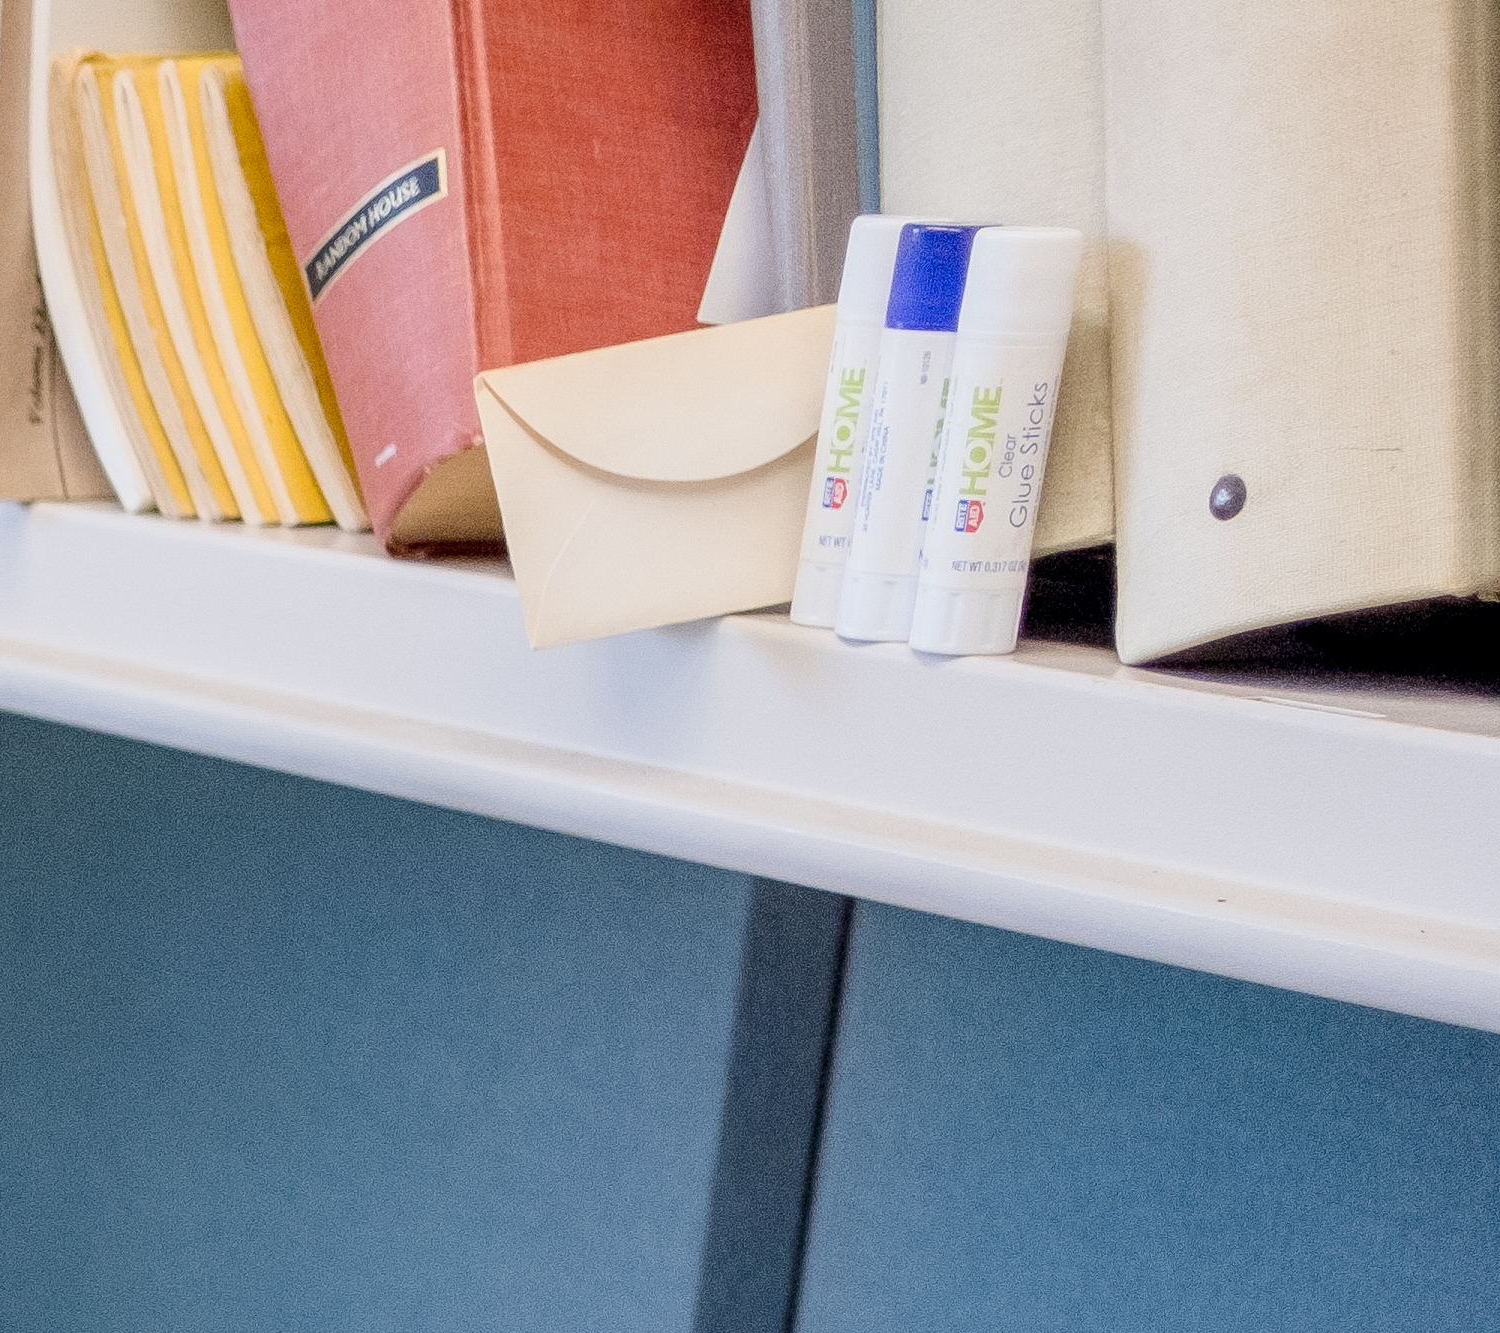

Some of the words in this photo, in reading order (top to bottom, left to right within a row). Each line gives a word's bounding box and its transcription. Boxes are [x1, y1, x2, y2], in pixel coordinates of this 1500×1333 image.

[315, 212, 368, 281] RANDOM
[368, 175, 421, 229] HOUSE
[827, 367, 866, 474] HOME
[959, 385, 1002, 497] HOME
[1019, 381, 1049, 456] Sticks
[998, 433, 1017, 479] Clear
[956, 501, 968, 531] RITE
[969, 506, 980, 528] AID
[1008, 464, 1035, 528] Glue
[833, 536, 845, 548] WT
[952, 560, 967, 572] NET
[969, 561, 983, 572] WT
